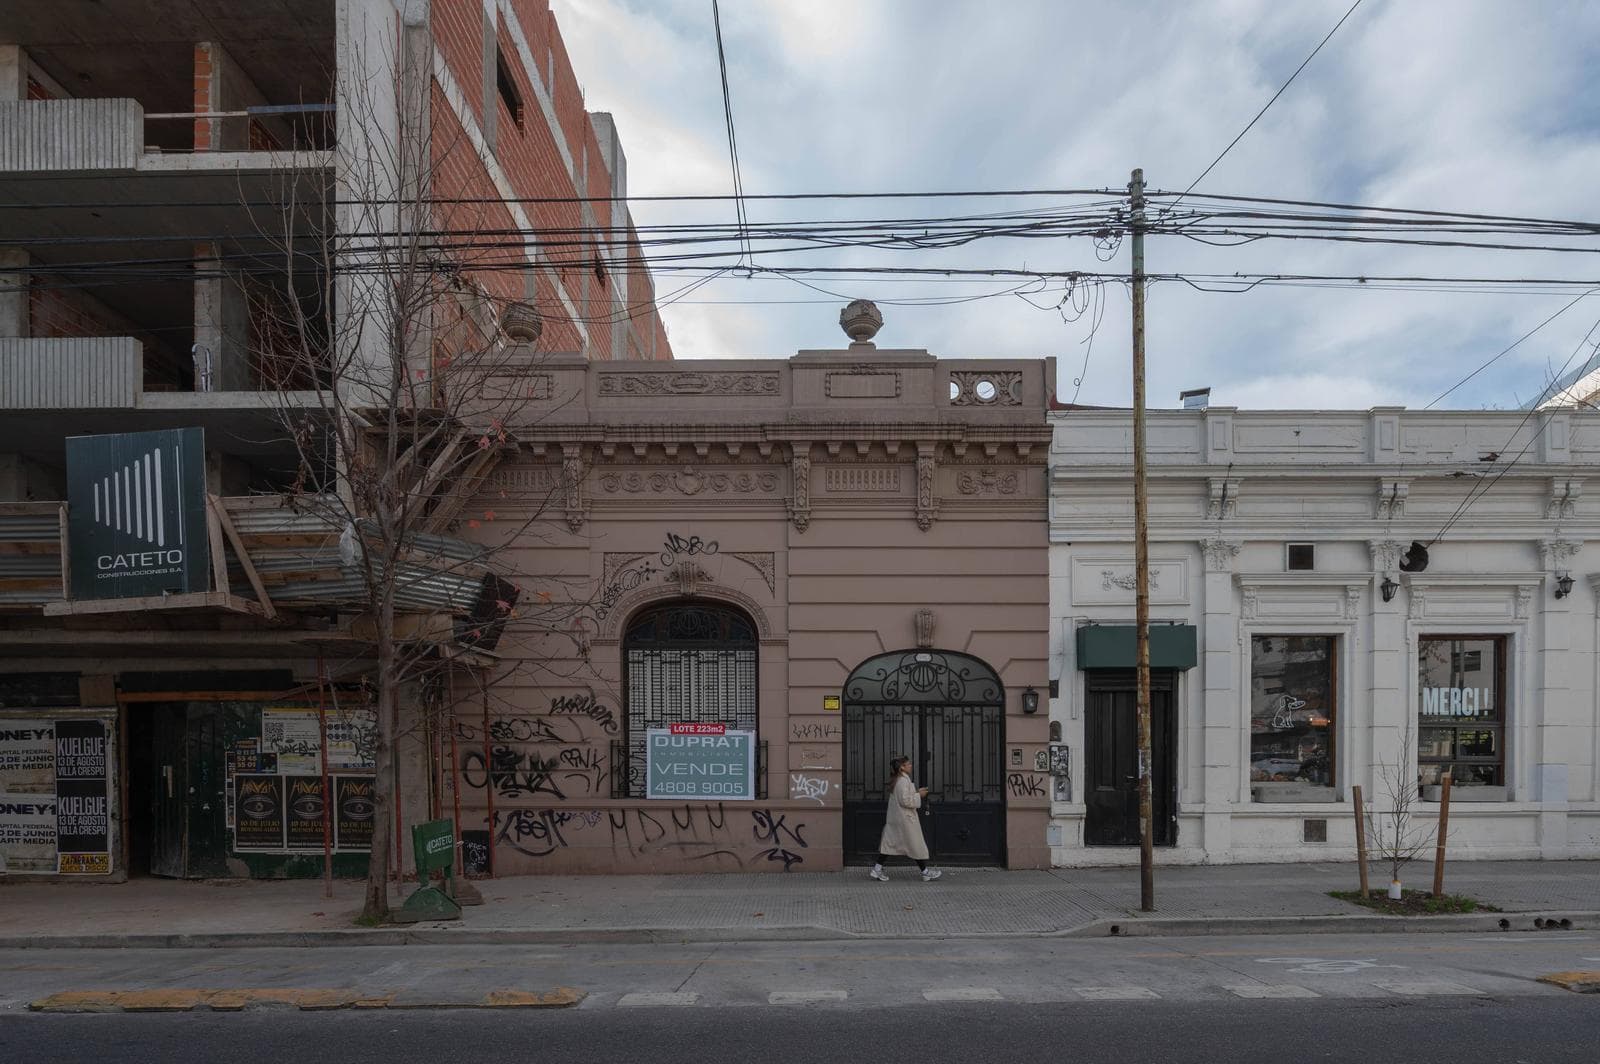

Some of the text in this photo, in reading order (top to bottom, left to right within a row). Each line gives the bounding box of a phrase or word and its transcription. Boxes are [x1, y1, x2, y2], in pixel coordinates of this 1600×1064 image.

[97, 549, 183, 570] CATETO
[97, 569, 168, 579] CONSTRUCCIONES
[1423, 687, 1480, 716] MERCI
[674, 725, 695, 733] LOTE
[57, 737, 104, 756] KUELGUE
[655, 737, 744, 748] DUPRAT
[22, 755, 55, 763] JUNIO
[58, 757, 104, 767] 13 DE AGOSTO
[58, 767, 105, 777] VILLA CRESPO
[656, 763, 744, 776] VENDE
[655, 782, 744, 793] 4808 9005
[58, 796, 106, 816] KUELGUE
[59, 816, 106, 826] 13 DE AGOSTO
[59, 826, 106, 836] VILLA CRESPO
